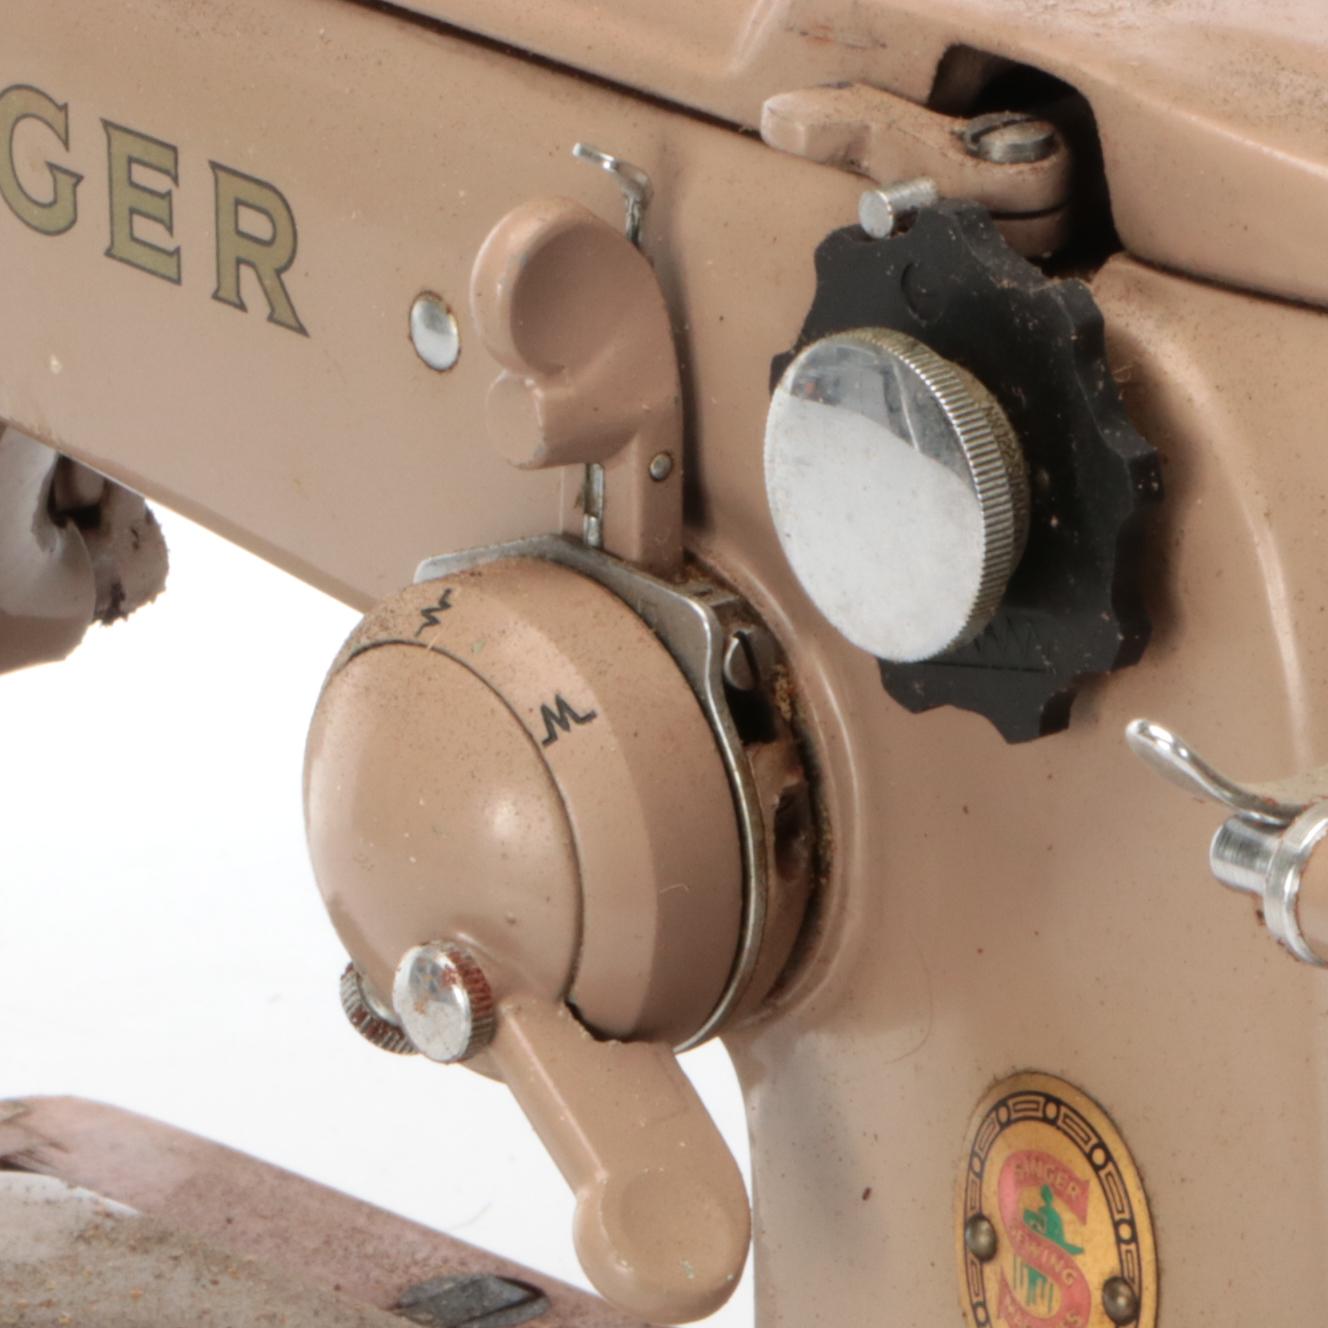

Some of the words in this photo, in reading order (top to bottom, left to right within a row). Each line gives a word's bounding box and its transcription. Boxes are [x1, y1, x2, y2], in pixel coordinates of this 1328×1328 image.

[0, 84, 310, 338] GER
[1013, 1156, 1080, 1198] SINGER
[1008, 1222, 1078, 1287] SEWING
